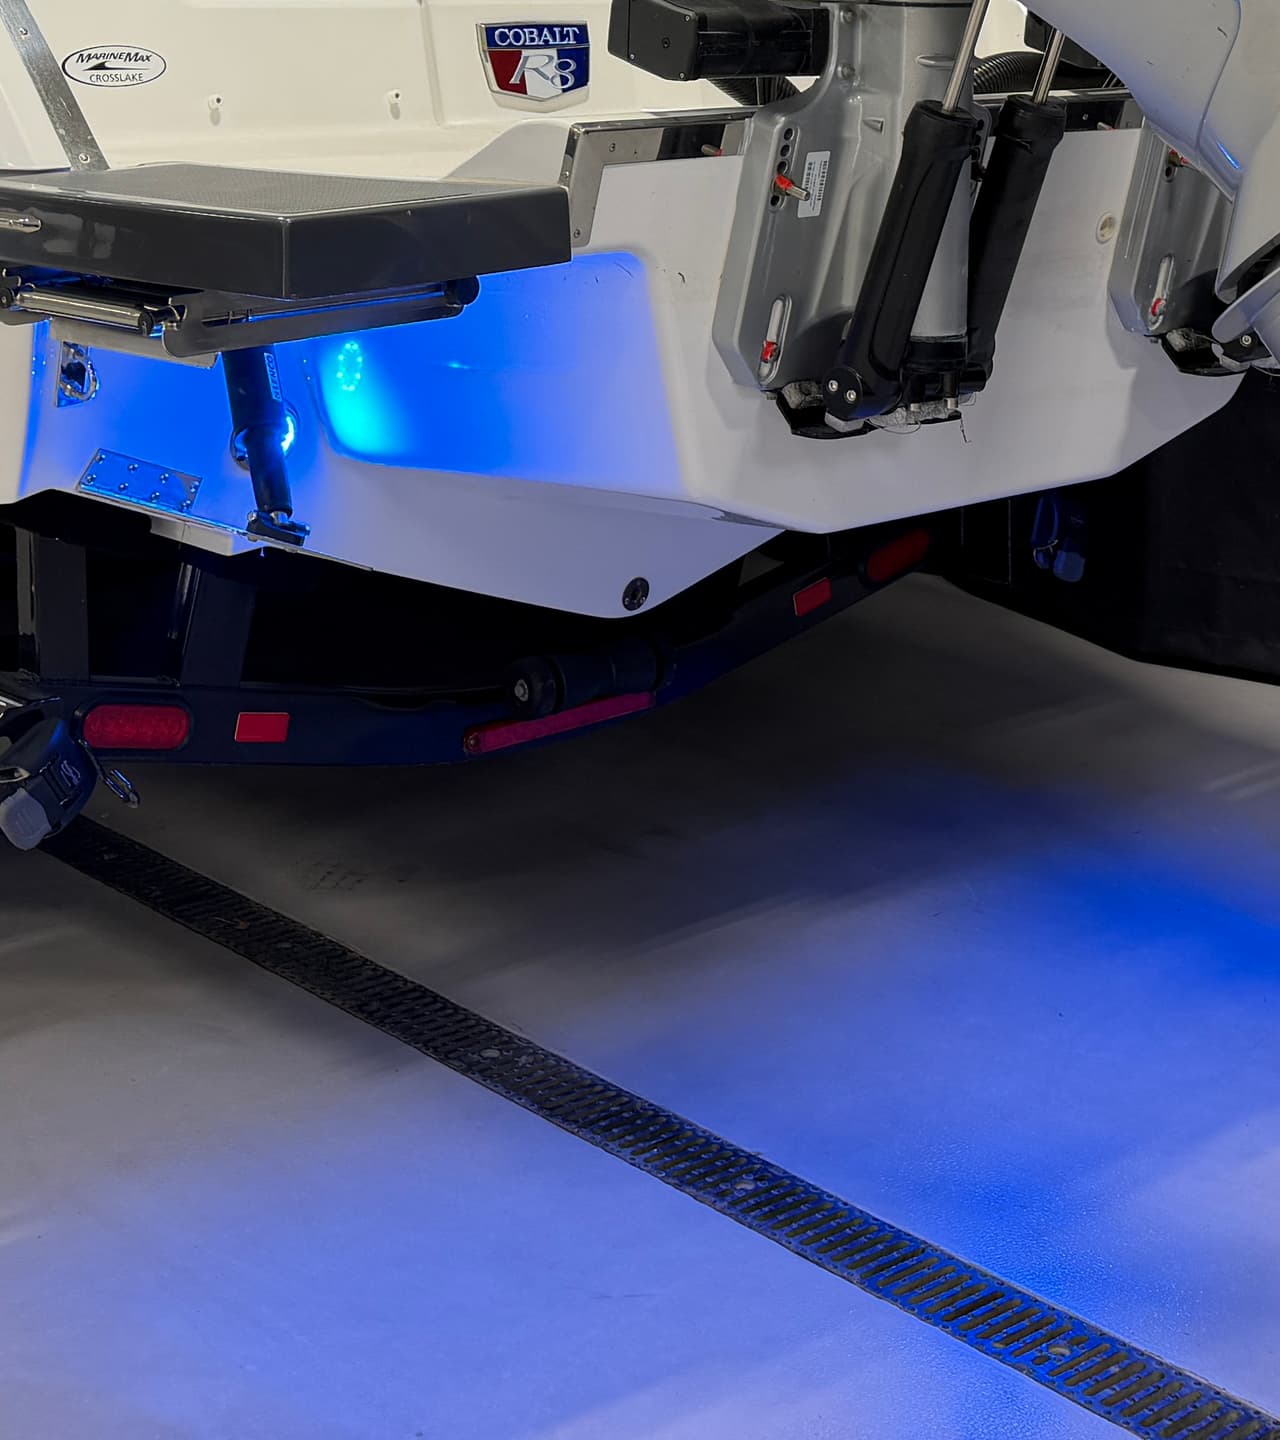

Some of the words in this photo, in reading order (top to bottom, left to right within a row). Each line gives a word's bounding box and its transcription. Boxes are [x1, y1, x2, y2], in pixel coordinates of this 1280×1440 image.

[494, 27, 580, 46] COBALT
[89, 73, 144, 83] CROSSLAKE
[508, 54, 577, 89] R8
